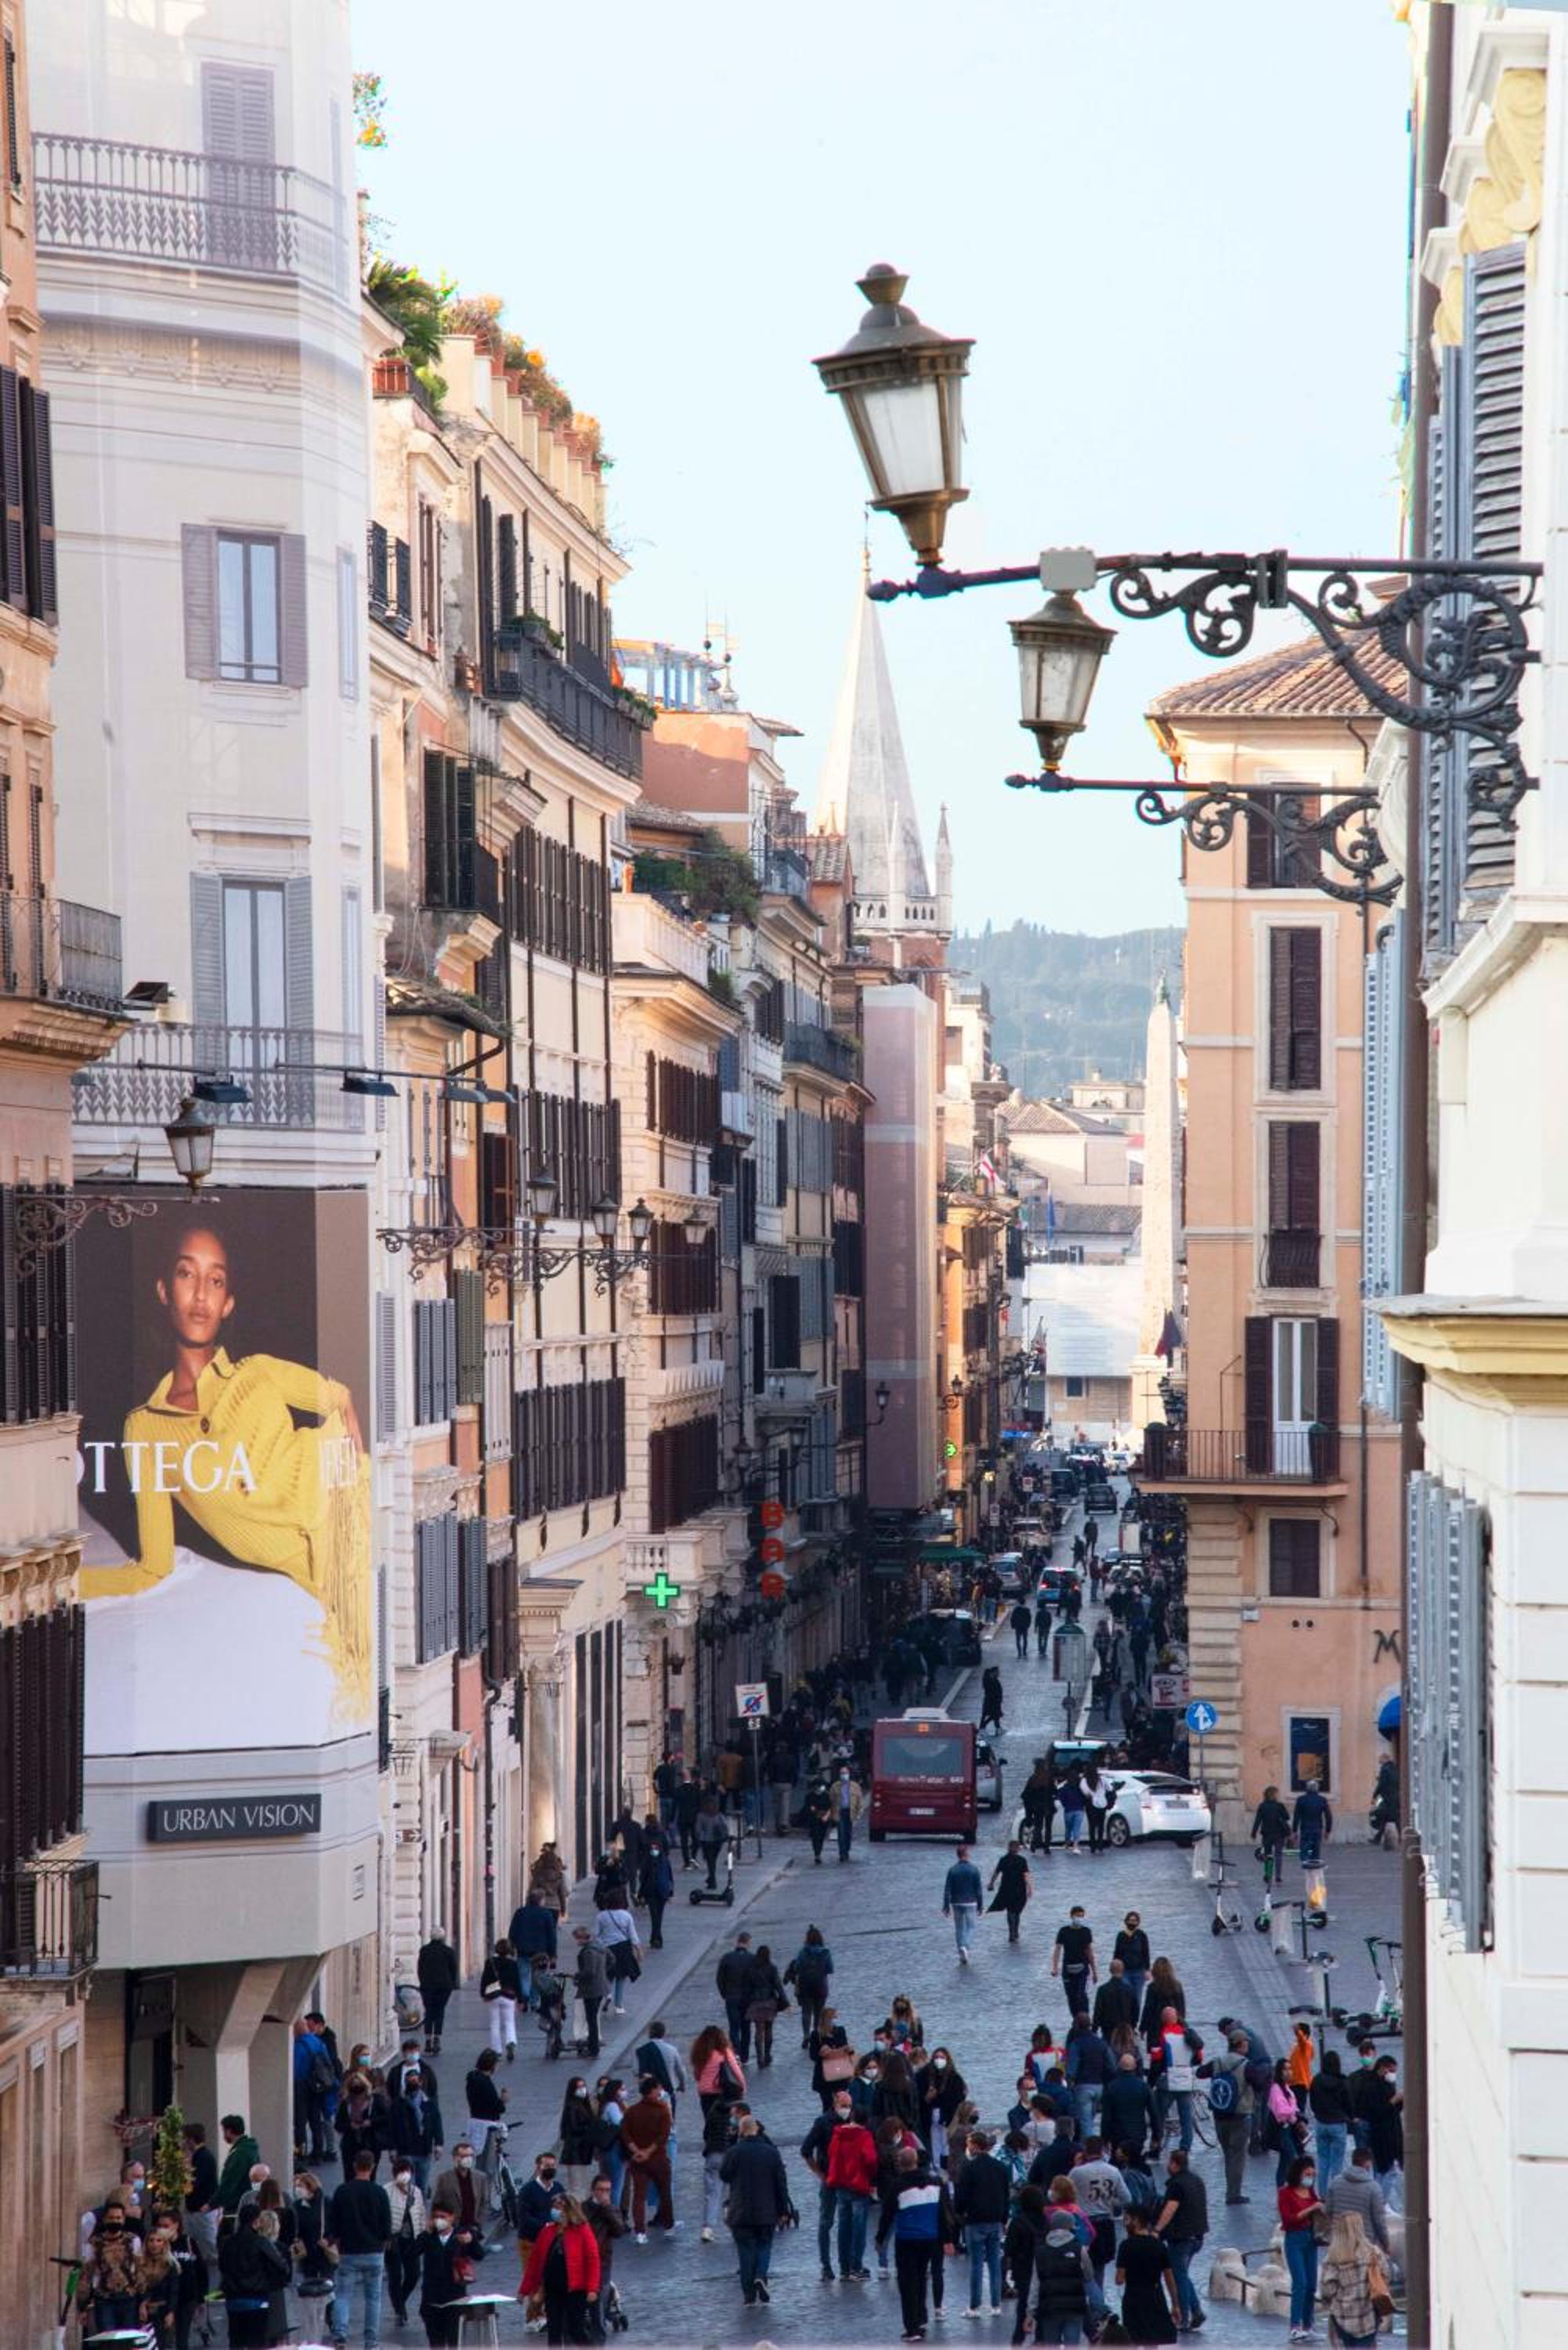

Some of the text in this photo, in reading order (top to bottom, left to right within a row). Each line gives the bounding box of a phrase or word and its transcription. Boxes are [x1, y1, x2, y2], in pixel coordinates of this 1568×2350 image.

[77, 1440, 258, 1492] TTEGA
[761, 1502, 784, 1600] BAR
[163, 1803, 314, 1832] URBAN VISION
[1088, 2178, 1114, 2202] 53
